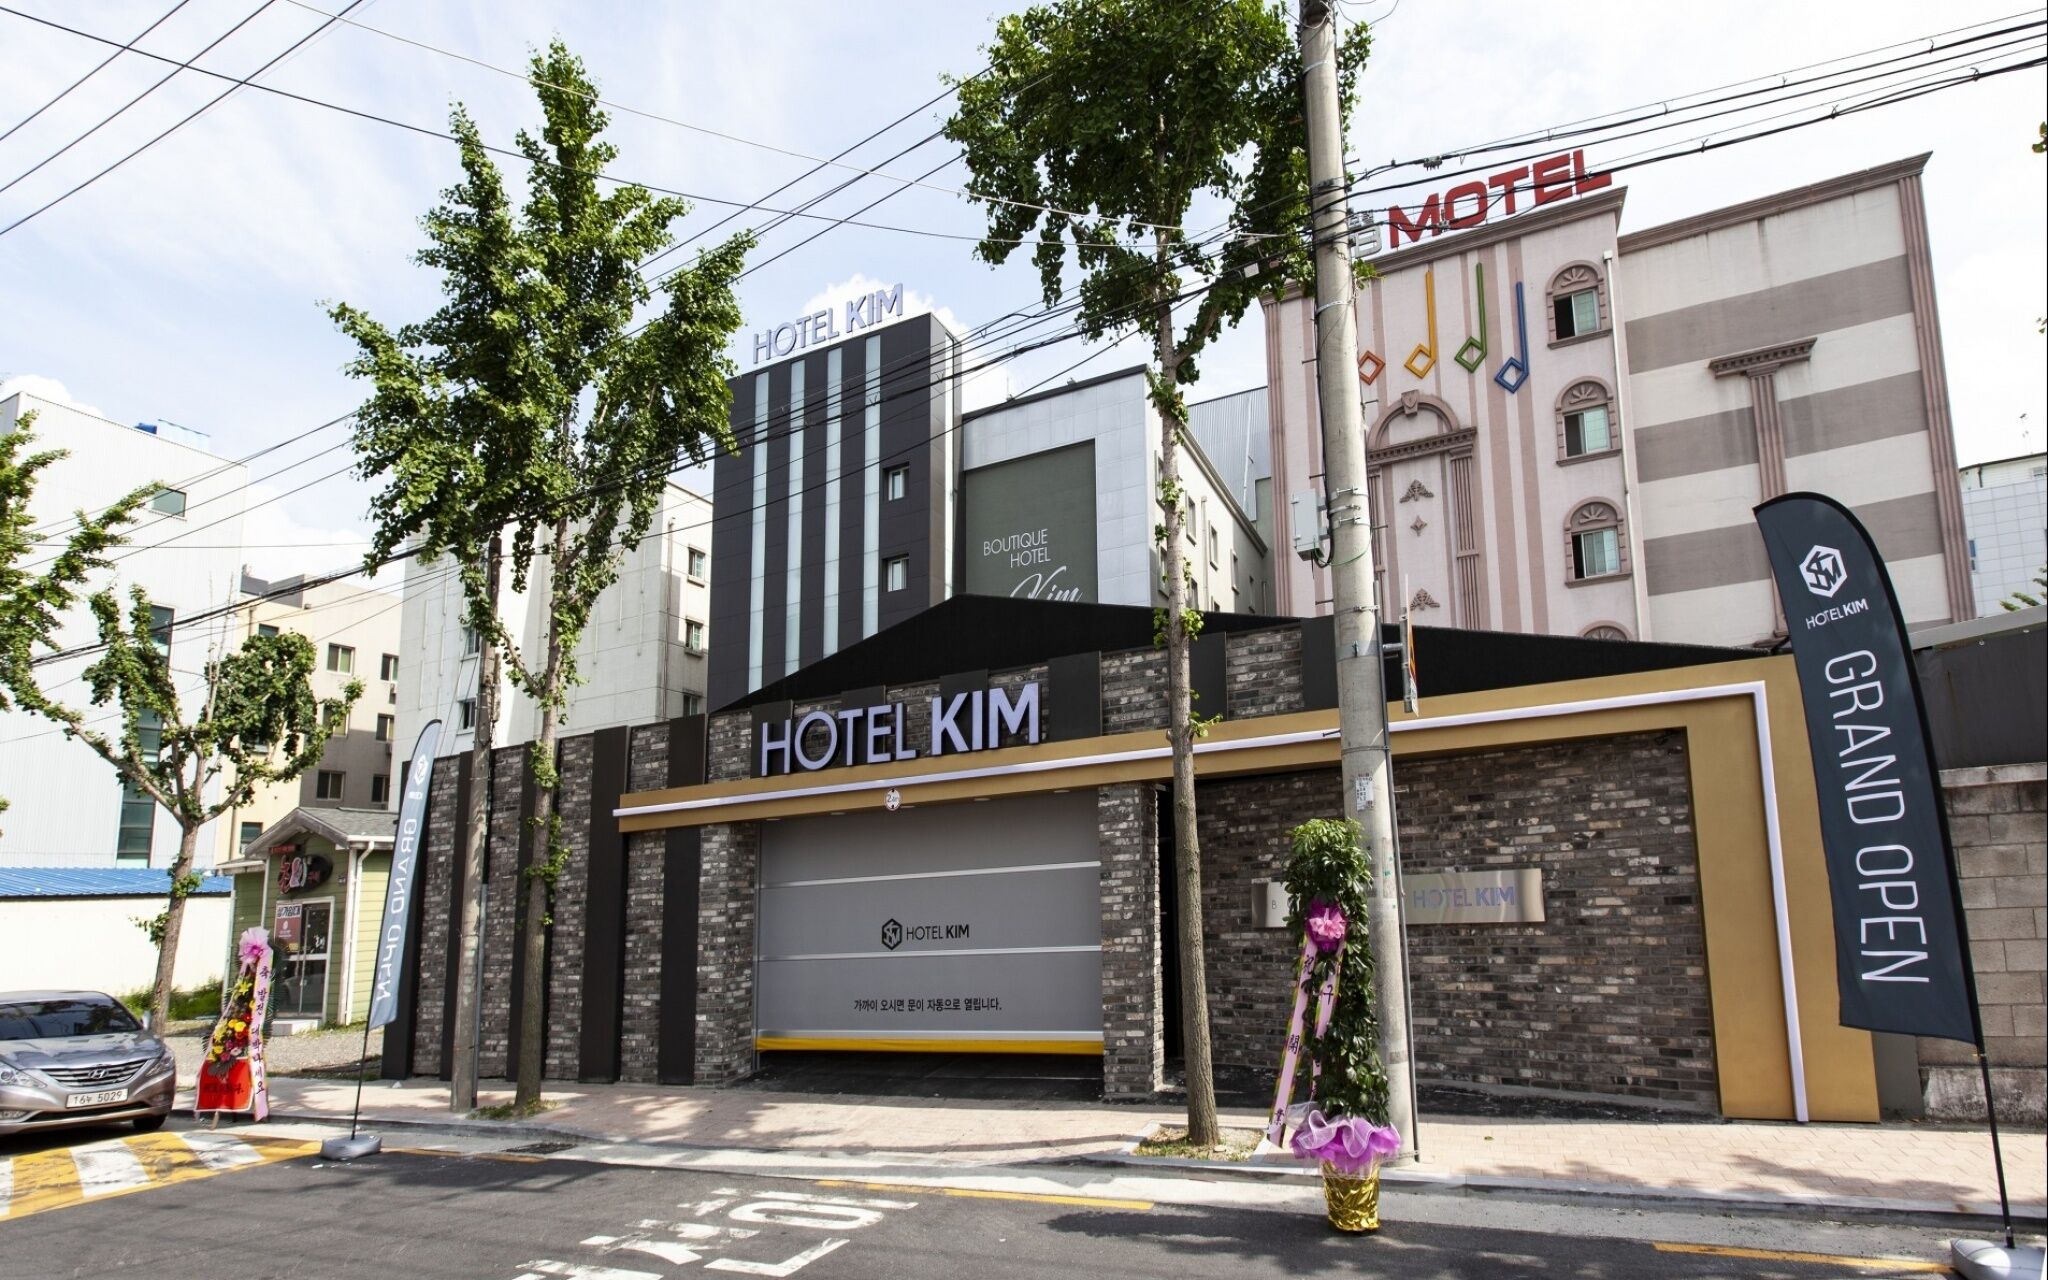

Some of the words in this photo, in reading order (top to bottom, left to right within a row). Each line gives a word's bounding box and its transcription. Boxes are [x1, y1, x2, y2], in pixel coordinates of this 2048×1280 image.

[1388, 149, 1612, 248] MOTEL
[753, 307, 839, 364] HOTEL
[846, 283, 903, 333] KIM
[983, 528, 1048, 556] BOUTIQUE
[1010, 547, 1051, 568] HOTEL
[1805, 607, 1845, 629] HOTEL
[1842, 598, 1869, 616] KIM
[761, 702, 917, 777] HOTEL
[931, 682, 1040, 756] KIM
[1824, 649, 1905, 825] GRAND
[1413, 888, 1473, 909] HOTEL
[1475, 886, 1515, 907] KIM
[1855, 844, 1930, 983] OPEN
[906, 925, 943, 941] HOTEL
[945, 924, 970, 939] KIM
[854, 999, 878, 1012] 가까이
[880, 998, 905, 1012] 오시면
[907, 998, 924, 1011] 문이
[927, 998, 961, 1011] 자동으로
[97, 1091, 123, 1102] 5029
